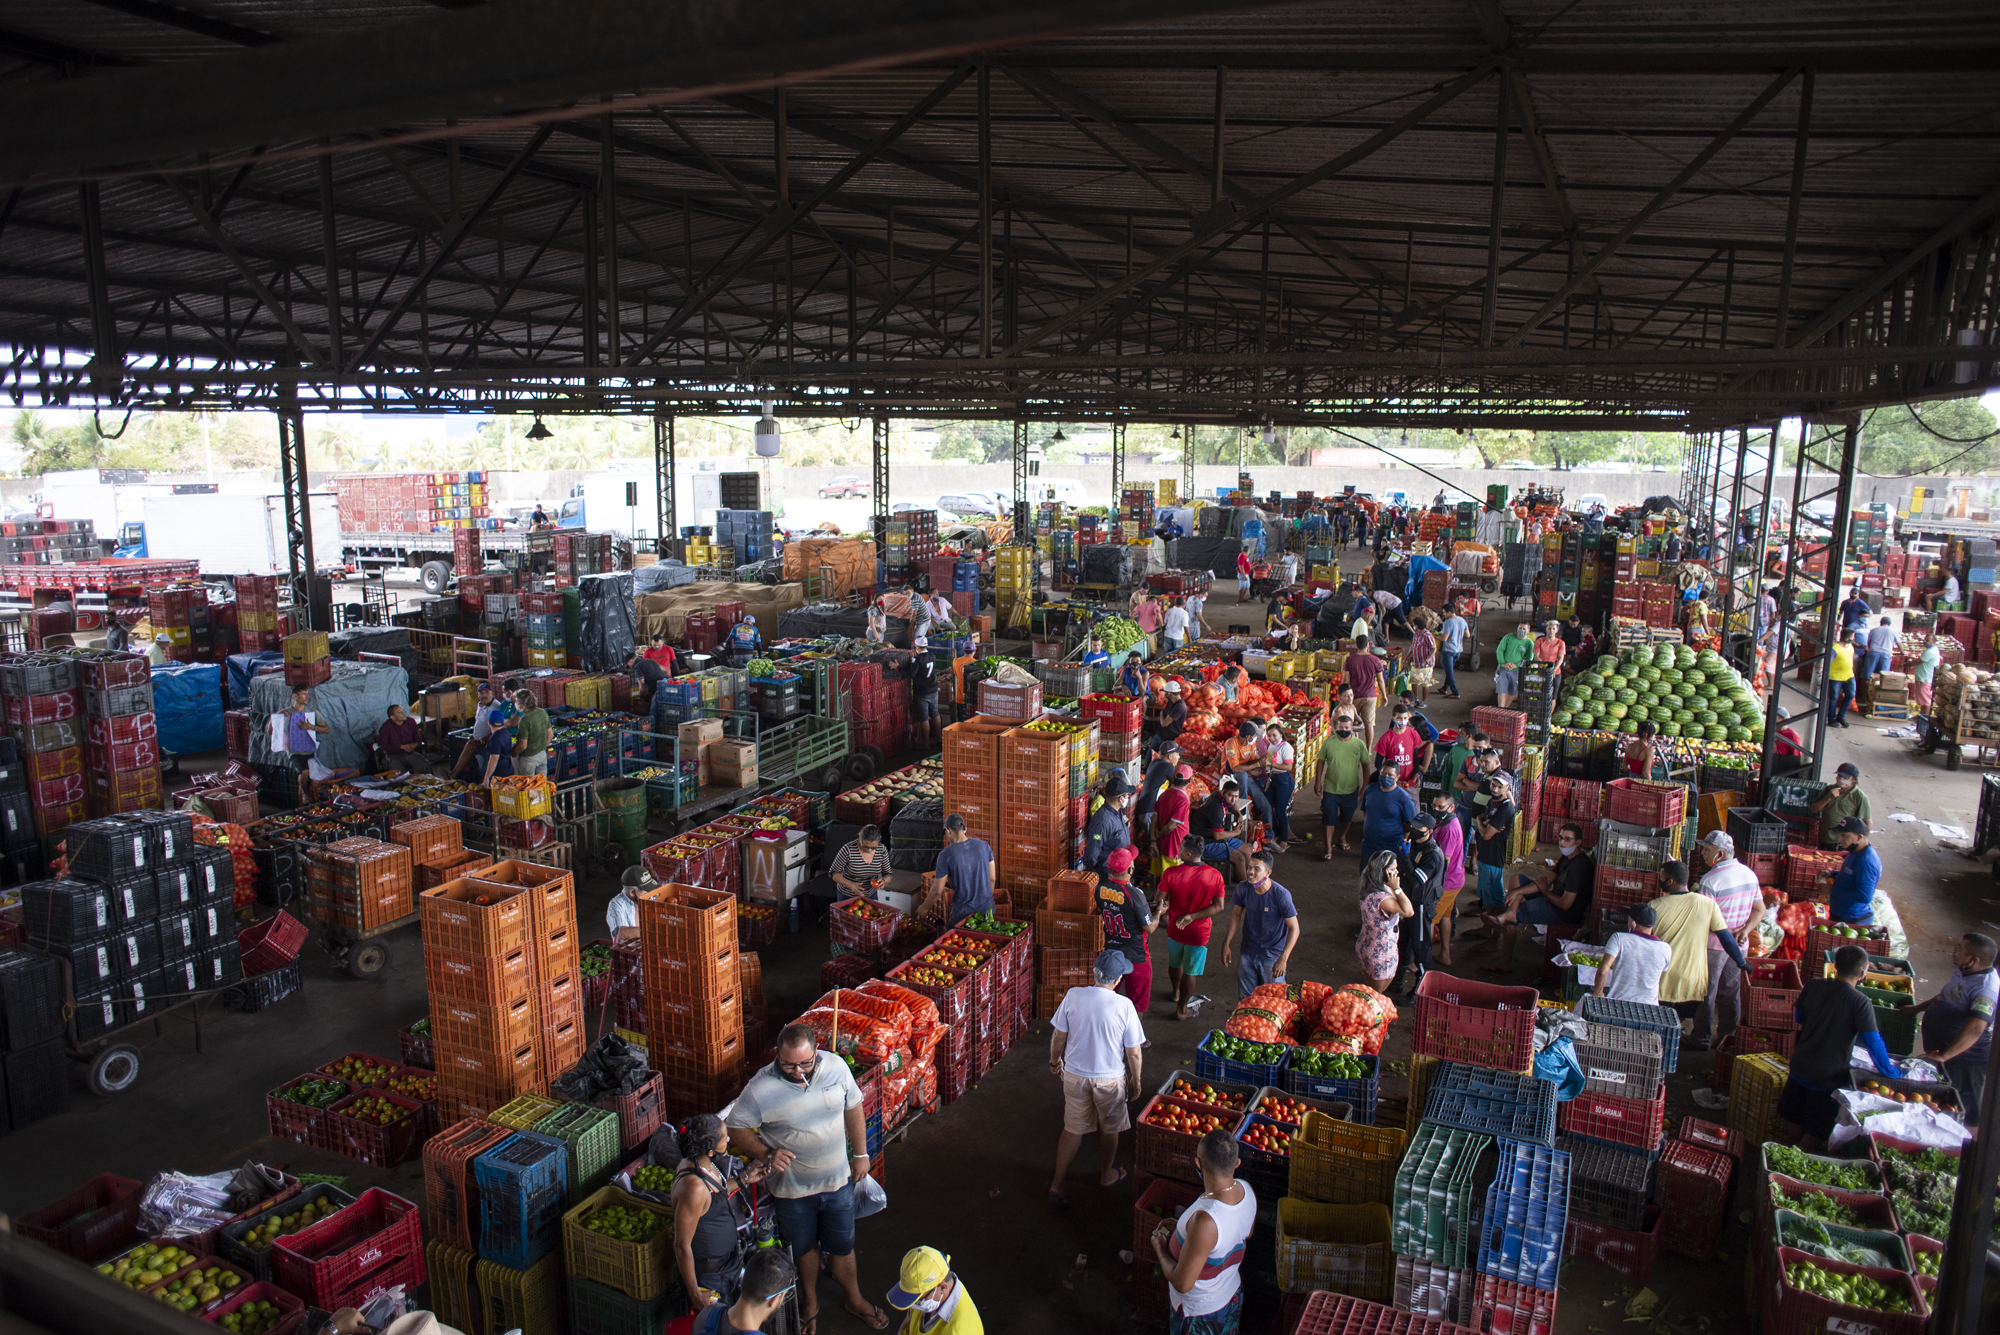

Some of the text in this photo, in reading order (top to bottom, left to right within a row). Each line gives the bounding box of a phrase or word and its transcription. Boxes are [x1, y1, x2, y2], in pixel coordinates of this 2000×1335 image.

[926, 662, 933, 678] 7
[1100, 886, 1124, 904] BMG
[1595, 1105, 1622, 1118] SÓ LARANJA
[1330, 1165, 1355, 1176] DUDU
[360, 1248, 382, 1262] VFL
[364, 1286, 386, 1299] VFL
